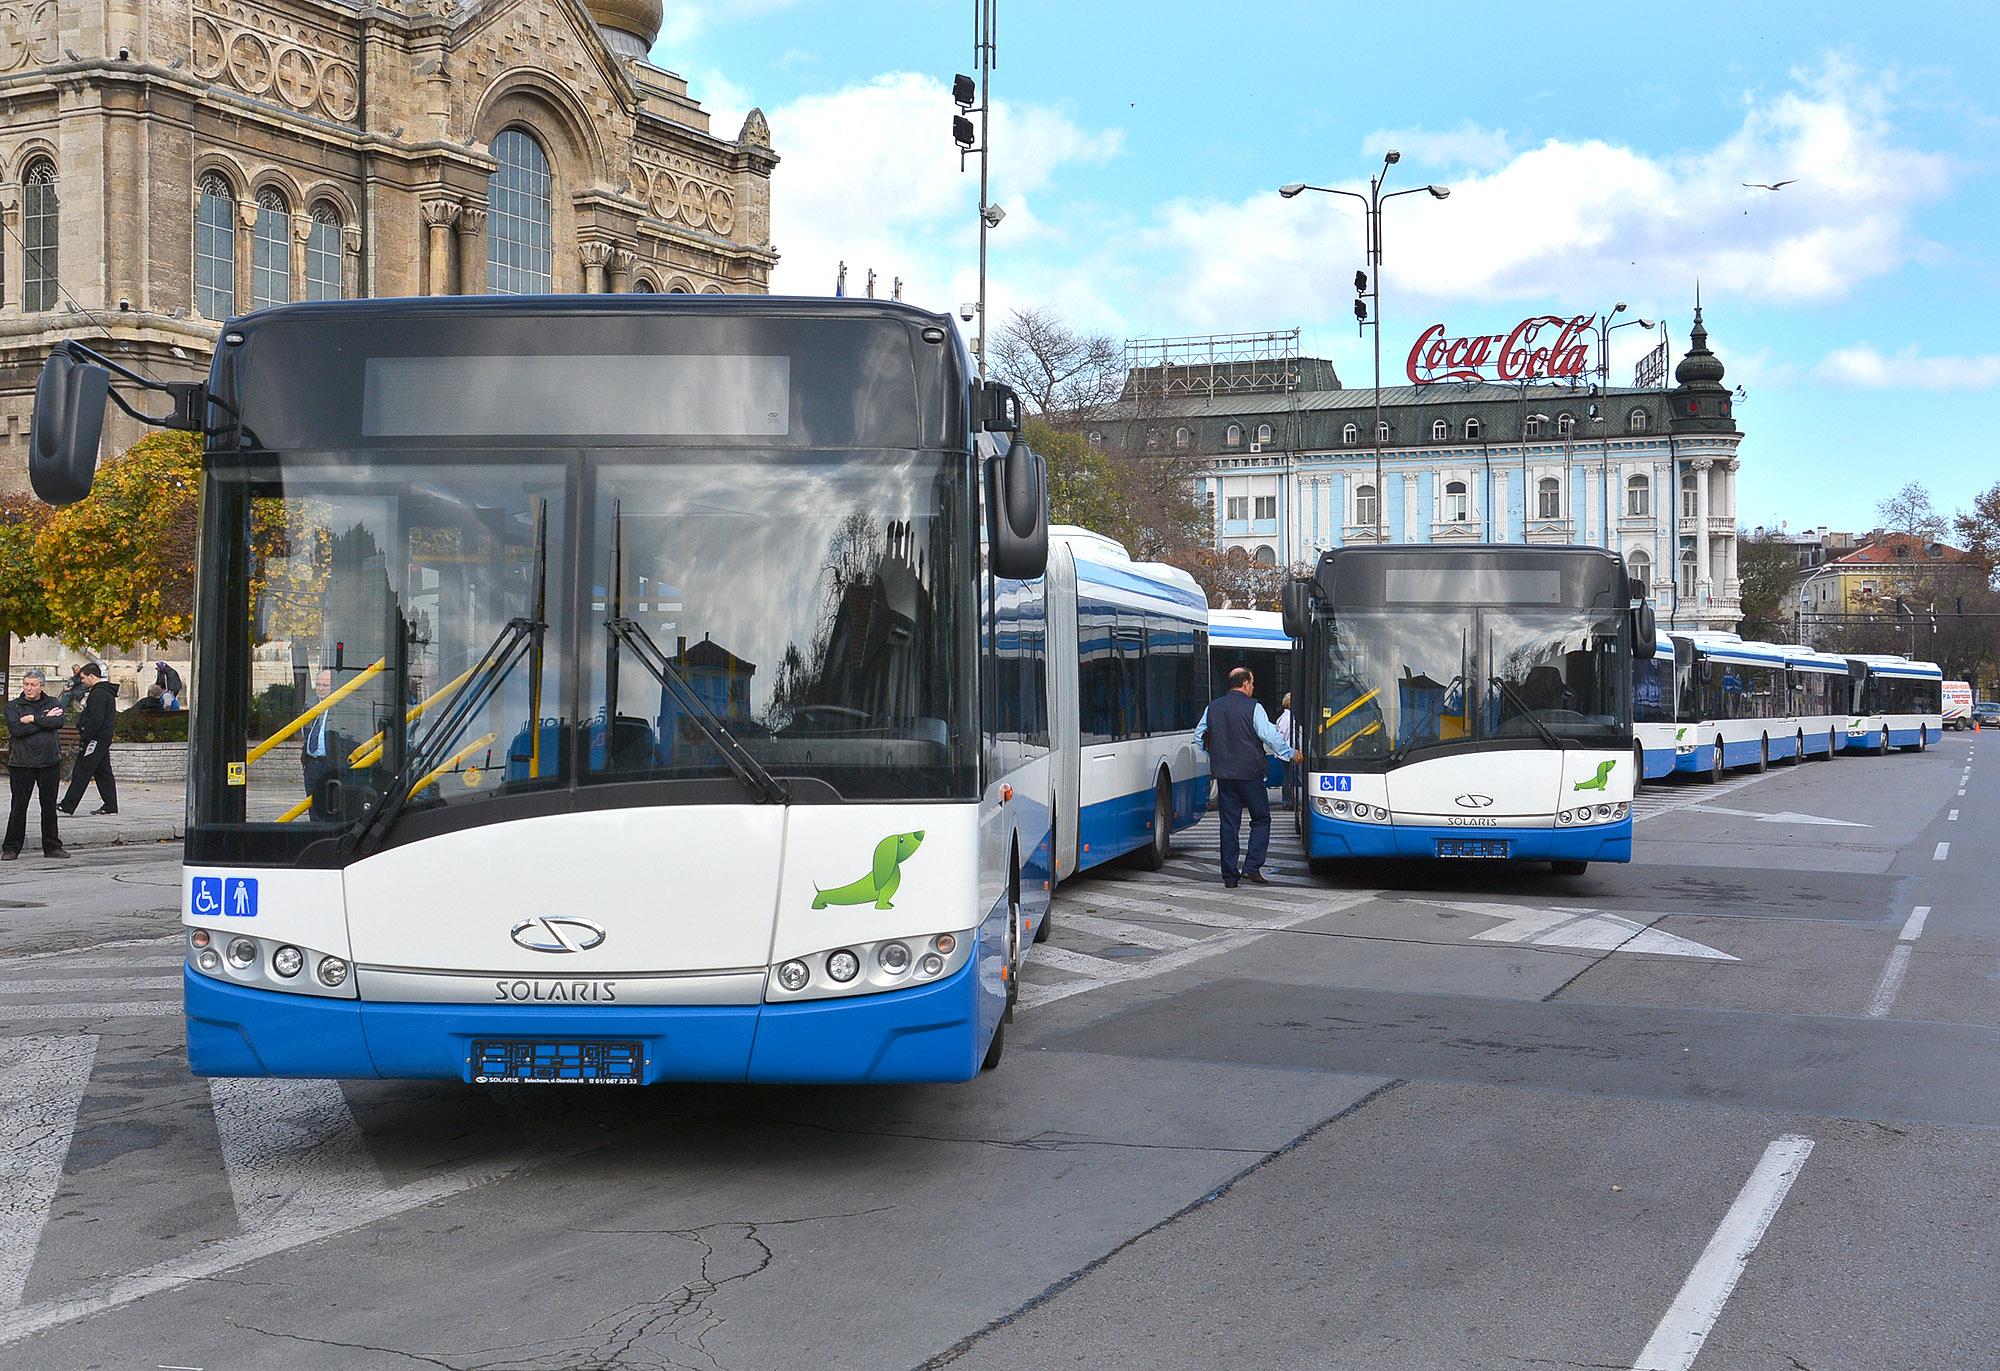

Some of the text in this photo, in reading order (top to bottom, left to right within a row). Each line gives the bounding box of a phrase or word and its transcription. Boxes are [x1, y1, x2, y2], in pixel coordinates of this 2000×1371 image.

[1406, 312, 1597, 385] Coca-Cola
[1448, 818, 1497, 826] SOLARIS
[495, 980, 616, 1002] SOLARIS
